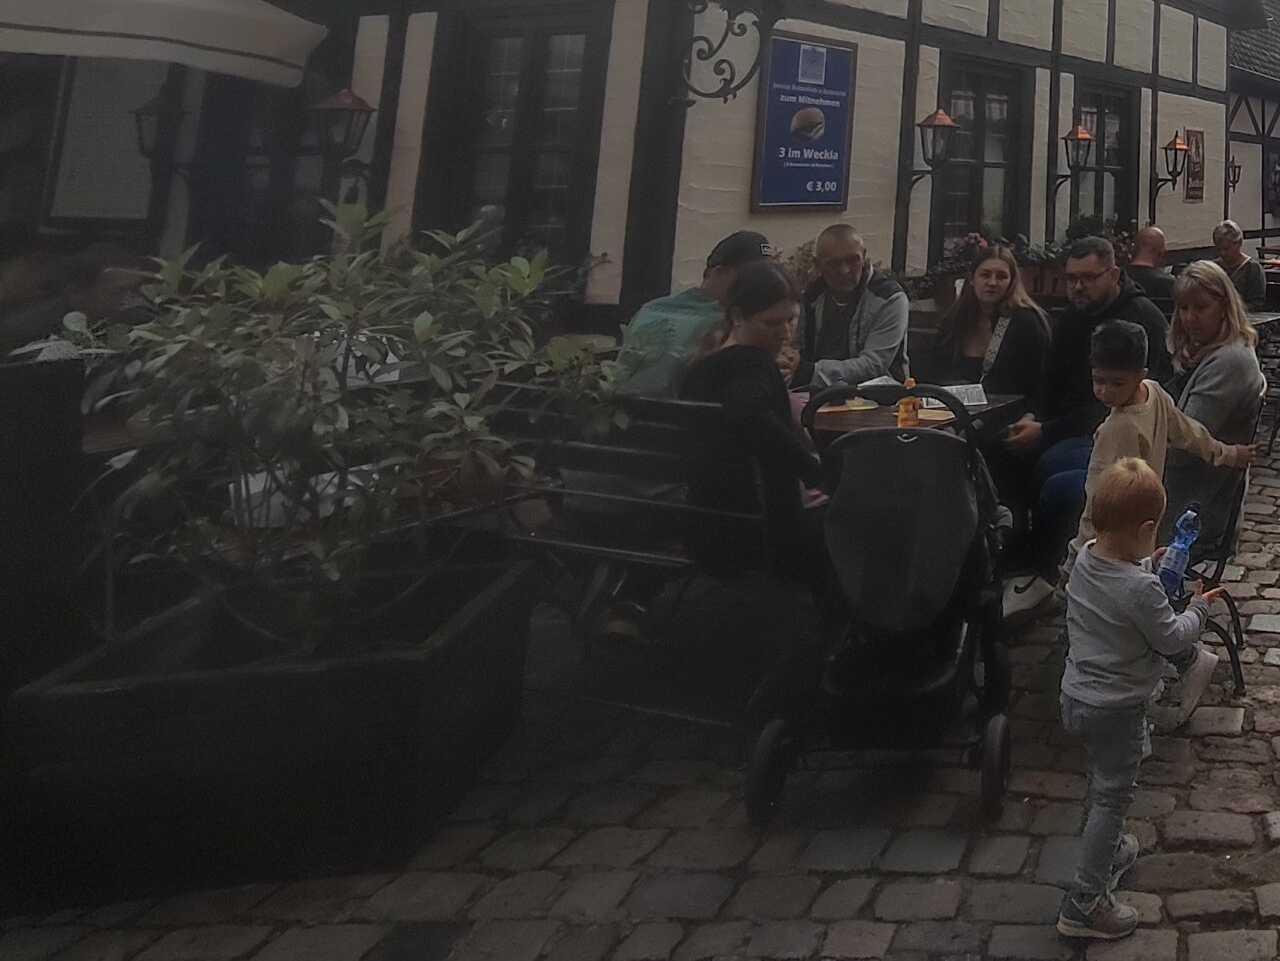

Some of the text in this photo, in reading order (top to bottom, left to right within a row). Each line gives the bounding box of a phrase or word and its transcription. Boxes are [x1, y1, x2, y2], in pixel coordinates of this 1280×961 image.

[778, 147, 786, 158] 3
[787, 147, 801, 159] im
[815, 181, 837, 193] 3,00
